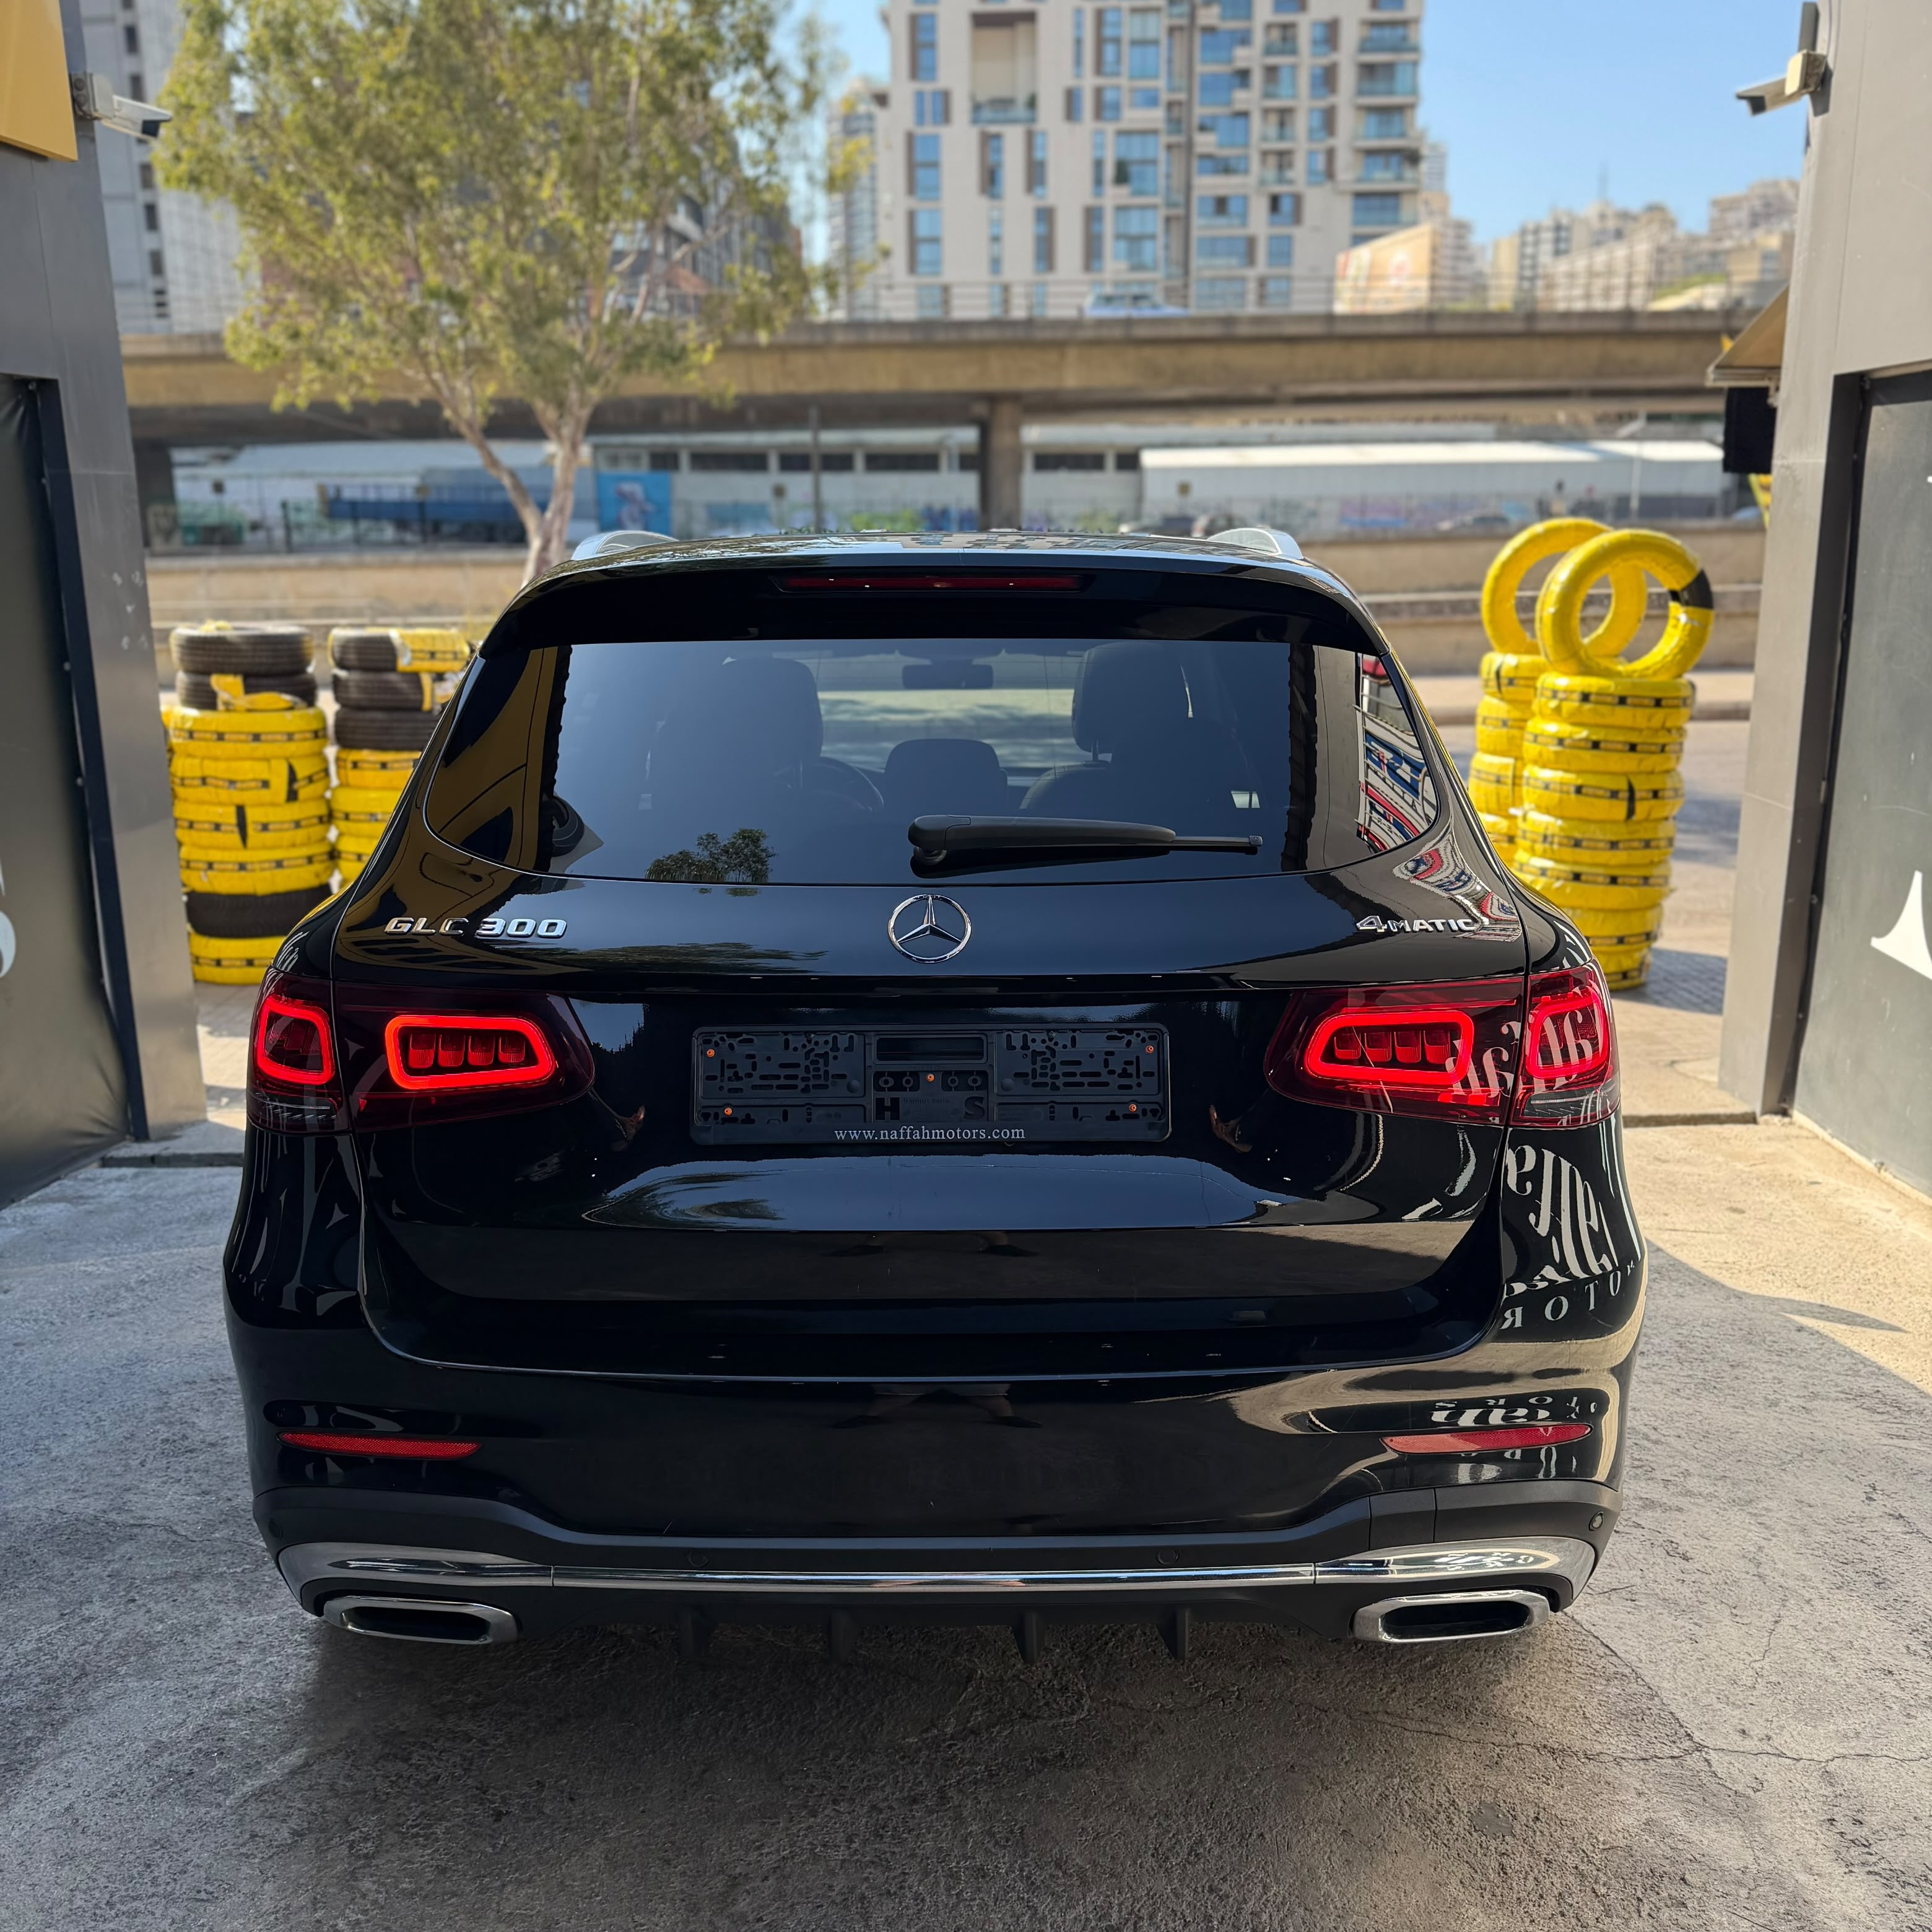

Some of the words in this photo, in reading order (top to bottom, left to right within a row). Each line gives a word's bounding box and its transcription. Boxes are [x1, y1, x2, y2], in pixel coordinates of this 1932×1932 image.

[384, 917, 469, 936] GLC
[475, 918, 568, 938] 300
[1356, 915, 1479, 933] 4MATIC
[834, 1125, 1025, 1140] www.naffahmotors.com
